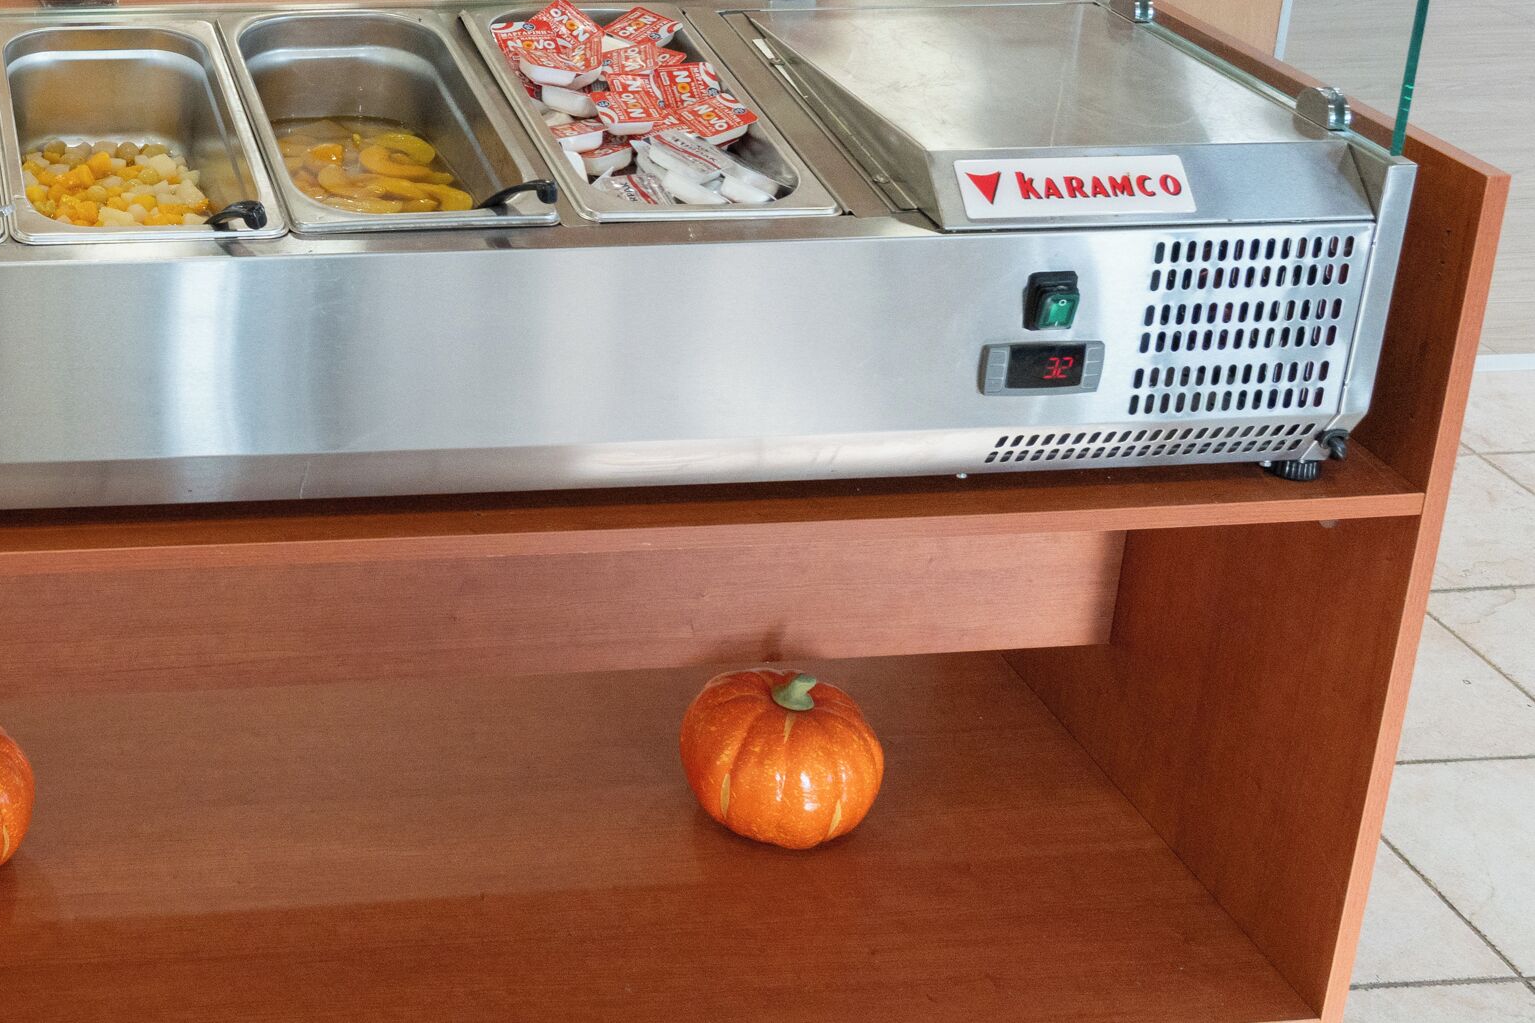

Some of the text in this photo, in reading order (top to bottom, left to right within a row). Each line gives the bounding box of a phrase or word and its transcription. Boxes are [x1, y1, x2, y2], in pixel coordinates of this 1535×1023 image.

[507, 38, 556, 52] NOVO
[693, 104, 728, 131] NOVO
[1015, 171, 1182, 200] KARAMCO
[1043, 357, 1074, 380] 32
